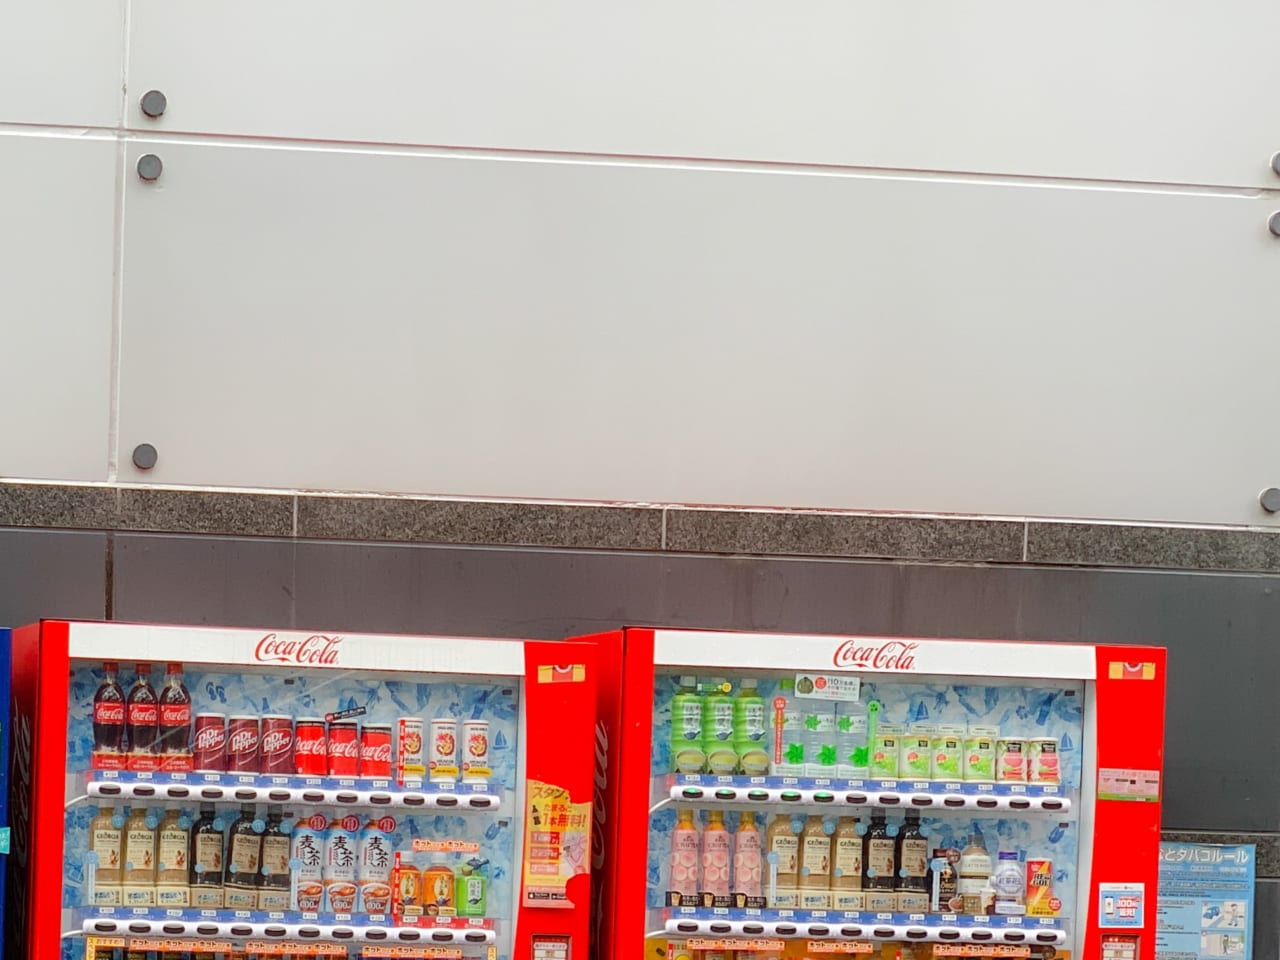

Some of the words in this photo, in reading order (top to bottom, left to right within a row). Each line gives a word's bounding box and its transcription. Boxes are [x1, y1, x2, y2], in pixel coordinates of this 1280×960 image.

[206, 729, 218, 739] Dr
[240, 730, 251, 741] Dr
[271, 731, 283, 741] Dr
[198, 734, 225, 749] Pepper
[232, 736, 258, 750] Pepper
[263, 736, 290, 751] Pepper
[543, 813, 586, 828] 1本無料!
[162, 833, 185, 841] GEORGIA
[414, 840, 432, 848] ホット
[299, 835, 321, 867] 麦茶
[333, 835, 354, 867] 麦茶
[368, 836, 389, 868] 麦茶
